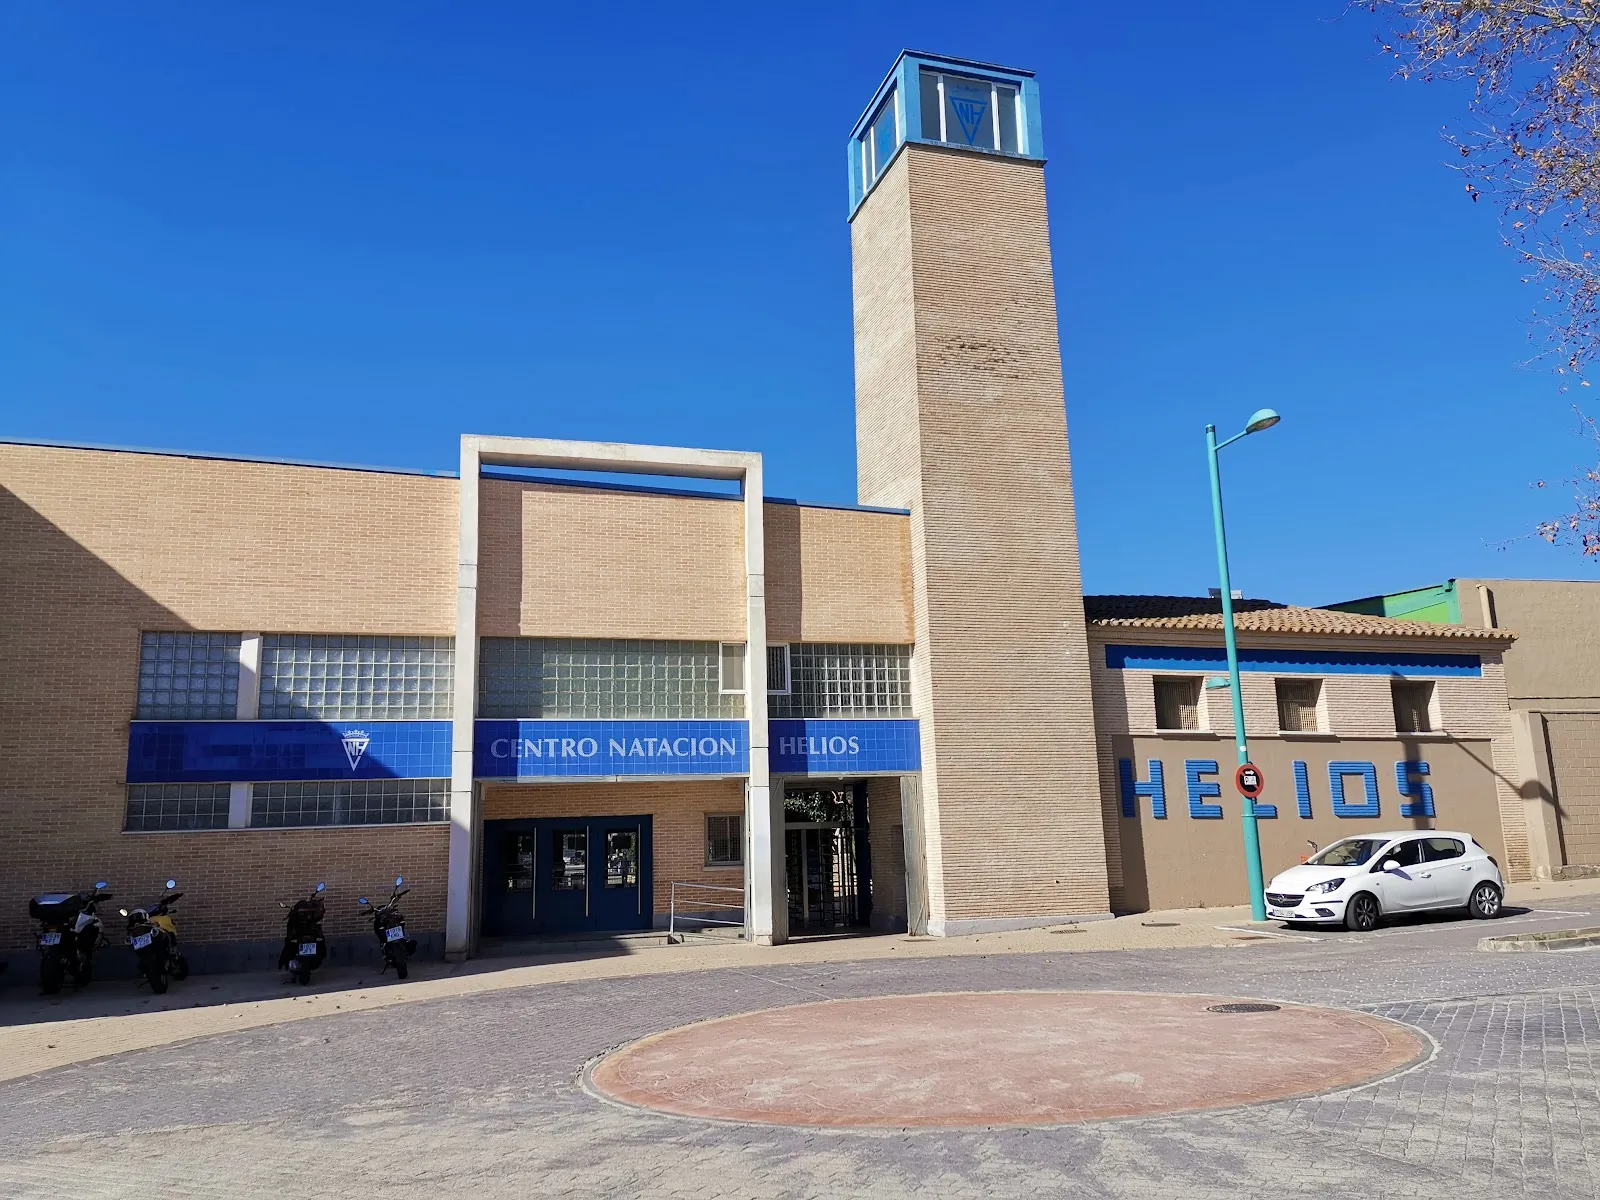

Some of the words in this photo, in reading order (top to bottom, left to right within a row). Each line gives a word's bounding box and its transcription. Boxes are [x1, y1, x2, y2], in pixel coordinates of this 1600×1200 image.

[491, 738, 598, 759] CENTRO
[609, 737, 736, 757] NATACION
[779, 736, 861, 756] HELIOS
